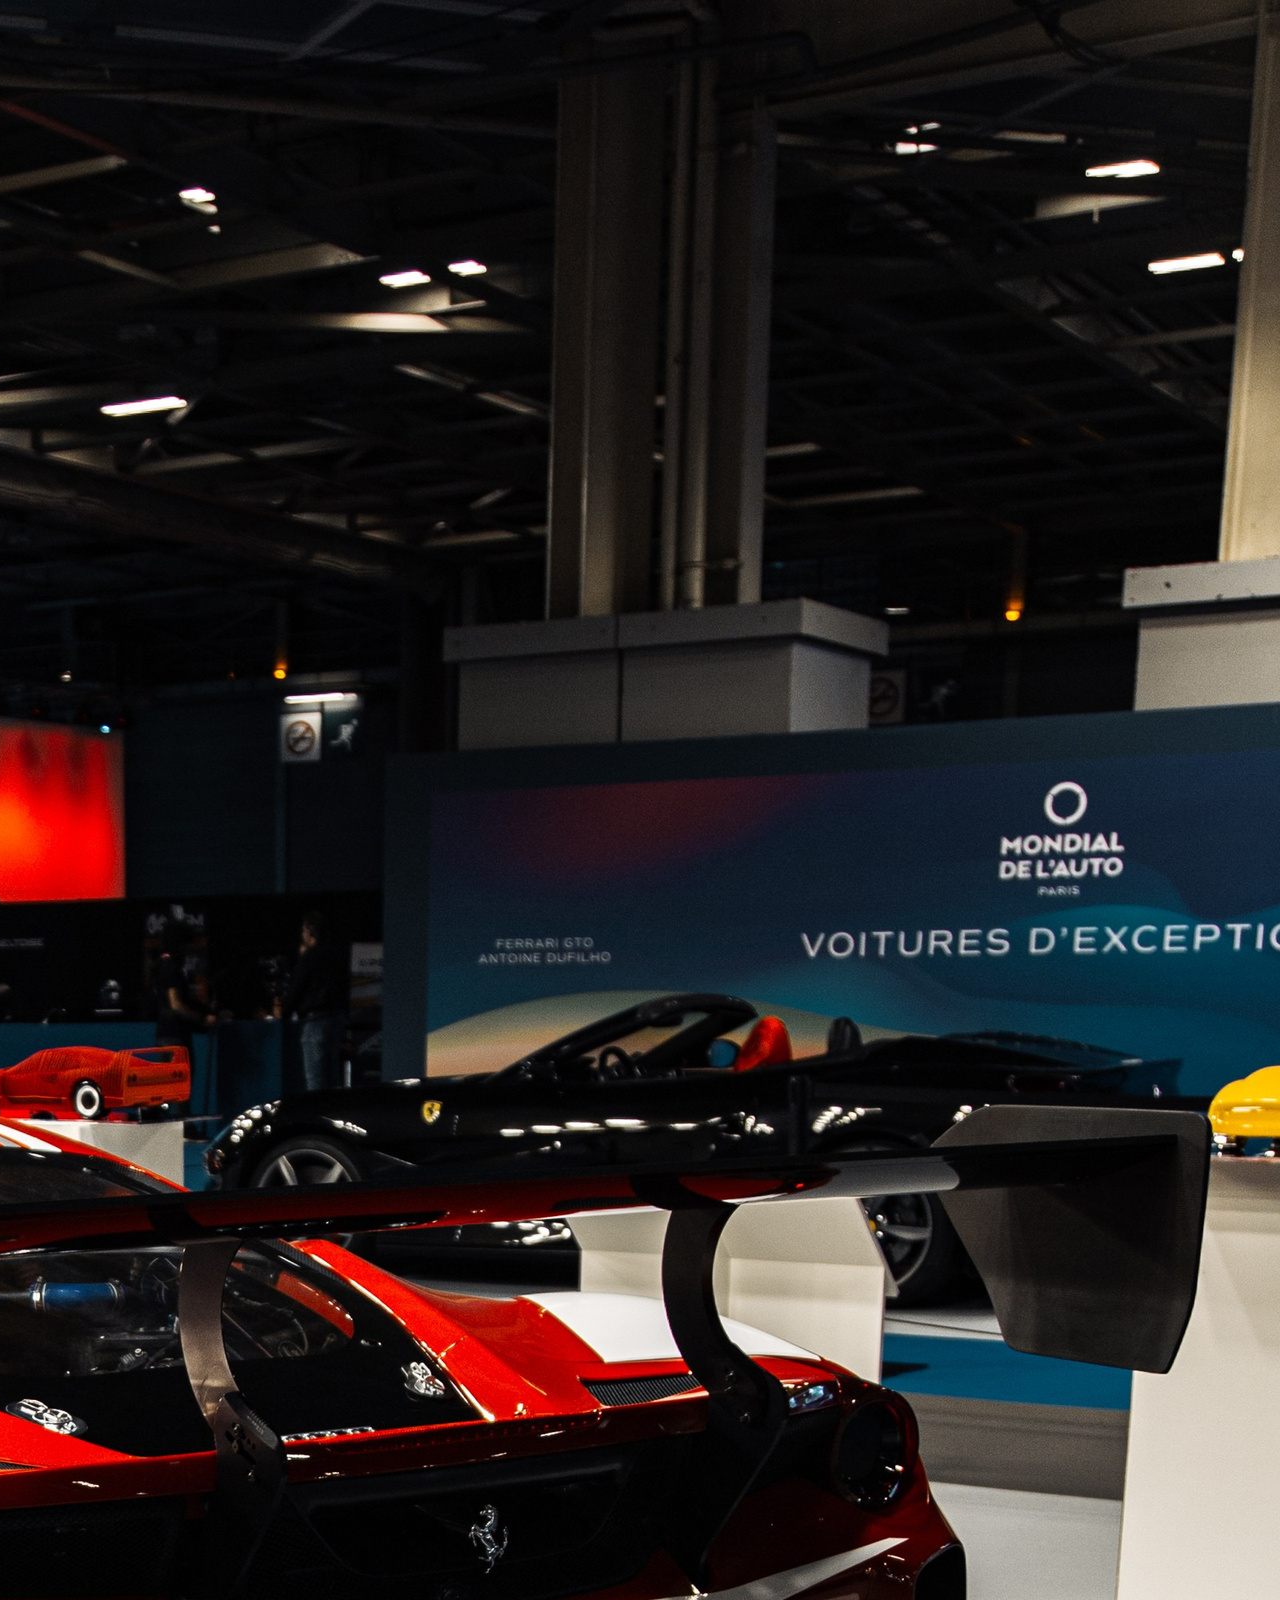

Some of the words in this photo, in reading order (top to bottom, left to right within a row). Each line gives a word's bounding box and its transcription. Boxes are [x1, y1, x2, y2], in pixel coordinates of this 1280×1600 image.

[1000, 832, 1125, 855] MONDIAL
[998, 860, 1032, 880] DE
[1036, 857, 1125, 878] L'AUTO
[1037, 884, 1081, 897] PARIS
[495, 937, 559, 950] FERRARI
[563, 936, 595, 949] GTO
[800, 927, 1011, 959] VOITURES
[478, 952, 542, 964] ANTOINE
[546, 951, 613, 964] DUFILHO
